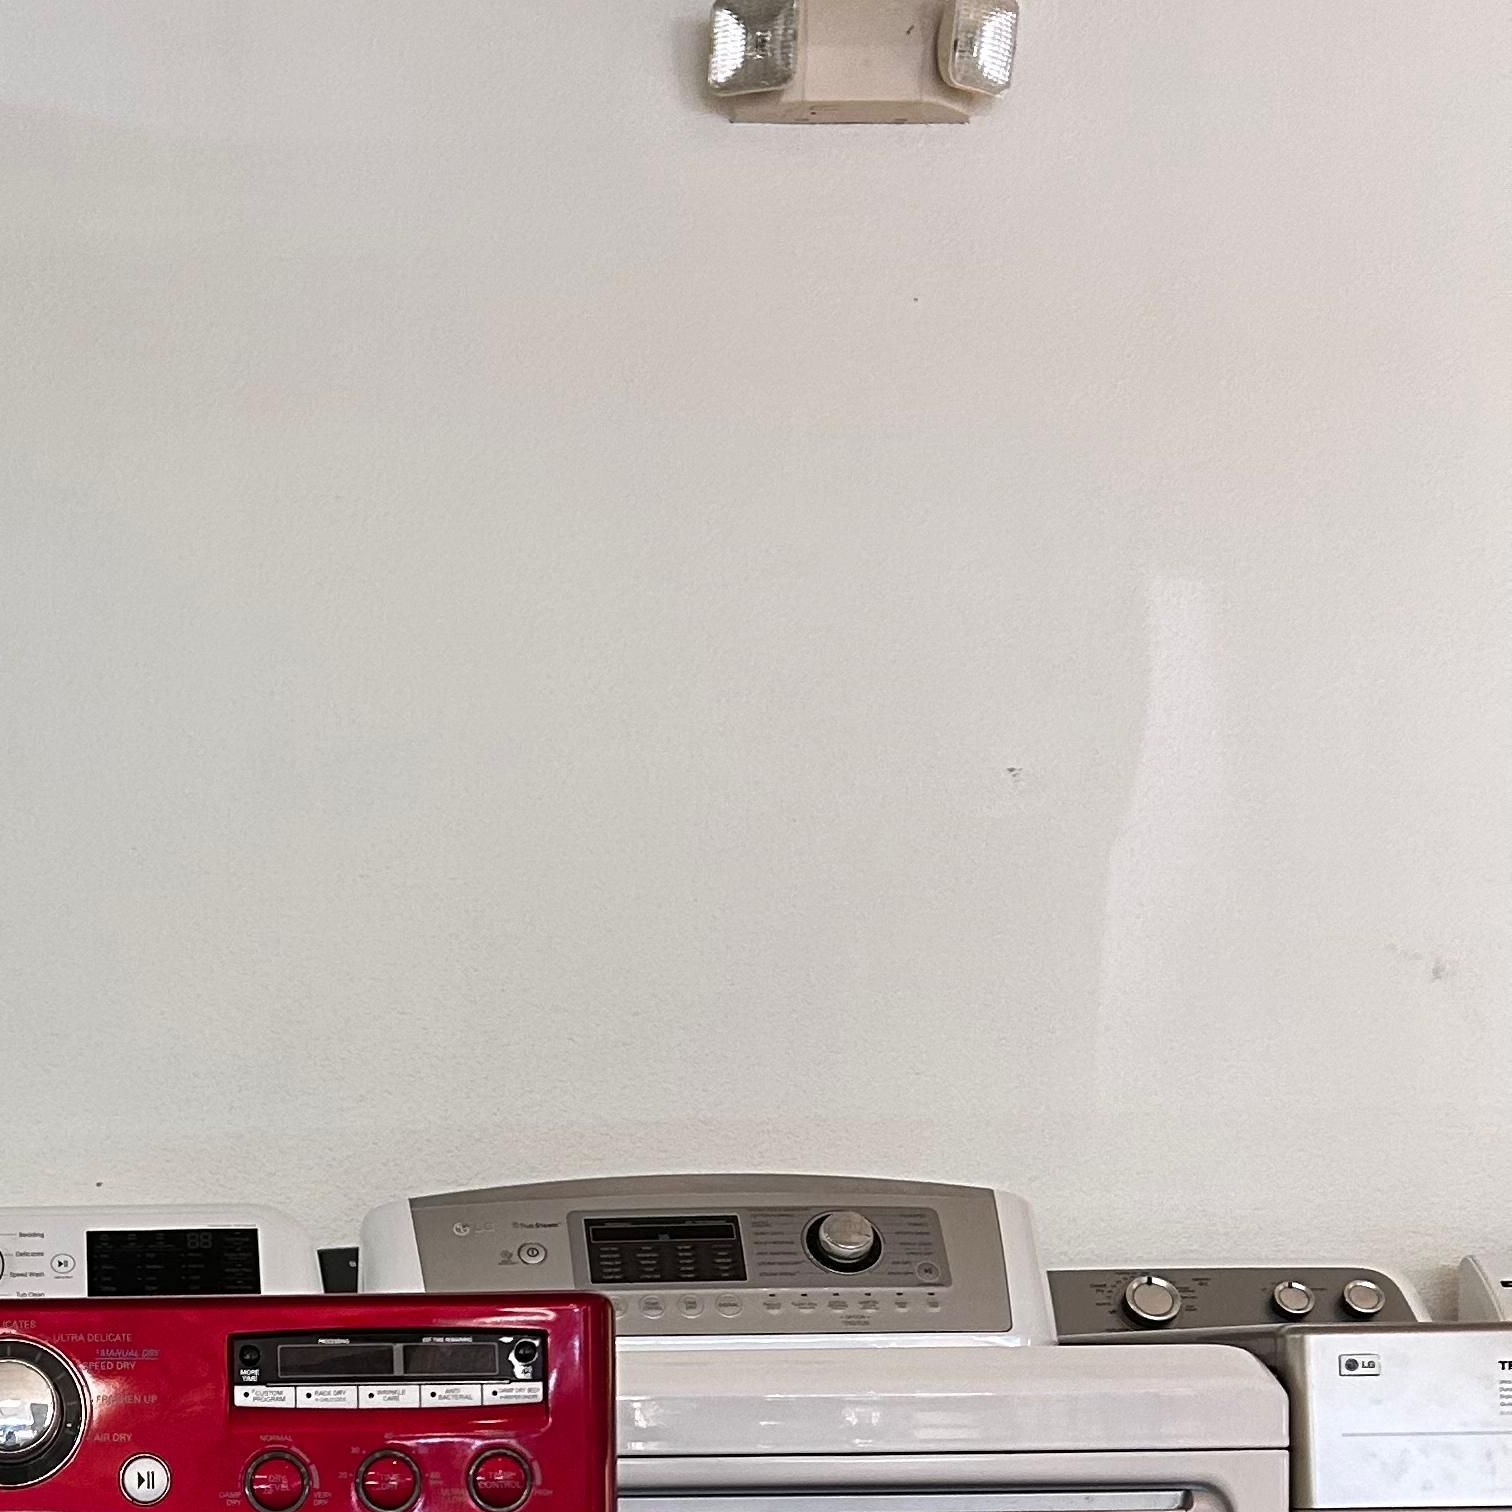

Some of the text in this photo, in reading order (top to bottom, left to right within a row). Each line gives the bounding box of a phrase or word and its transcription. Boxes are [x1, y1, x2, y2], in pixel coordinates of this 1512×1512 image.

[52, 1333, 133, 1342] ULTRA DELICATE
[83, 1361, 136, 1371] SPEED DRY
[1361, 1360, 1376, 1369] LG
[240, 1368, 260, 1376] MORE
[143, 1394, 158, 1404] UP
[94, 1433, 132, 1442] AIR DRY
[478, 1481, 523, 1489] CONTROL
